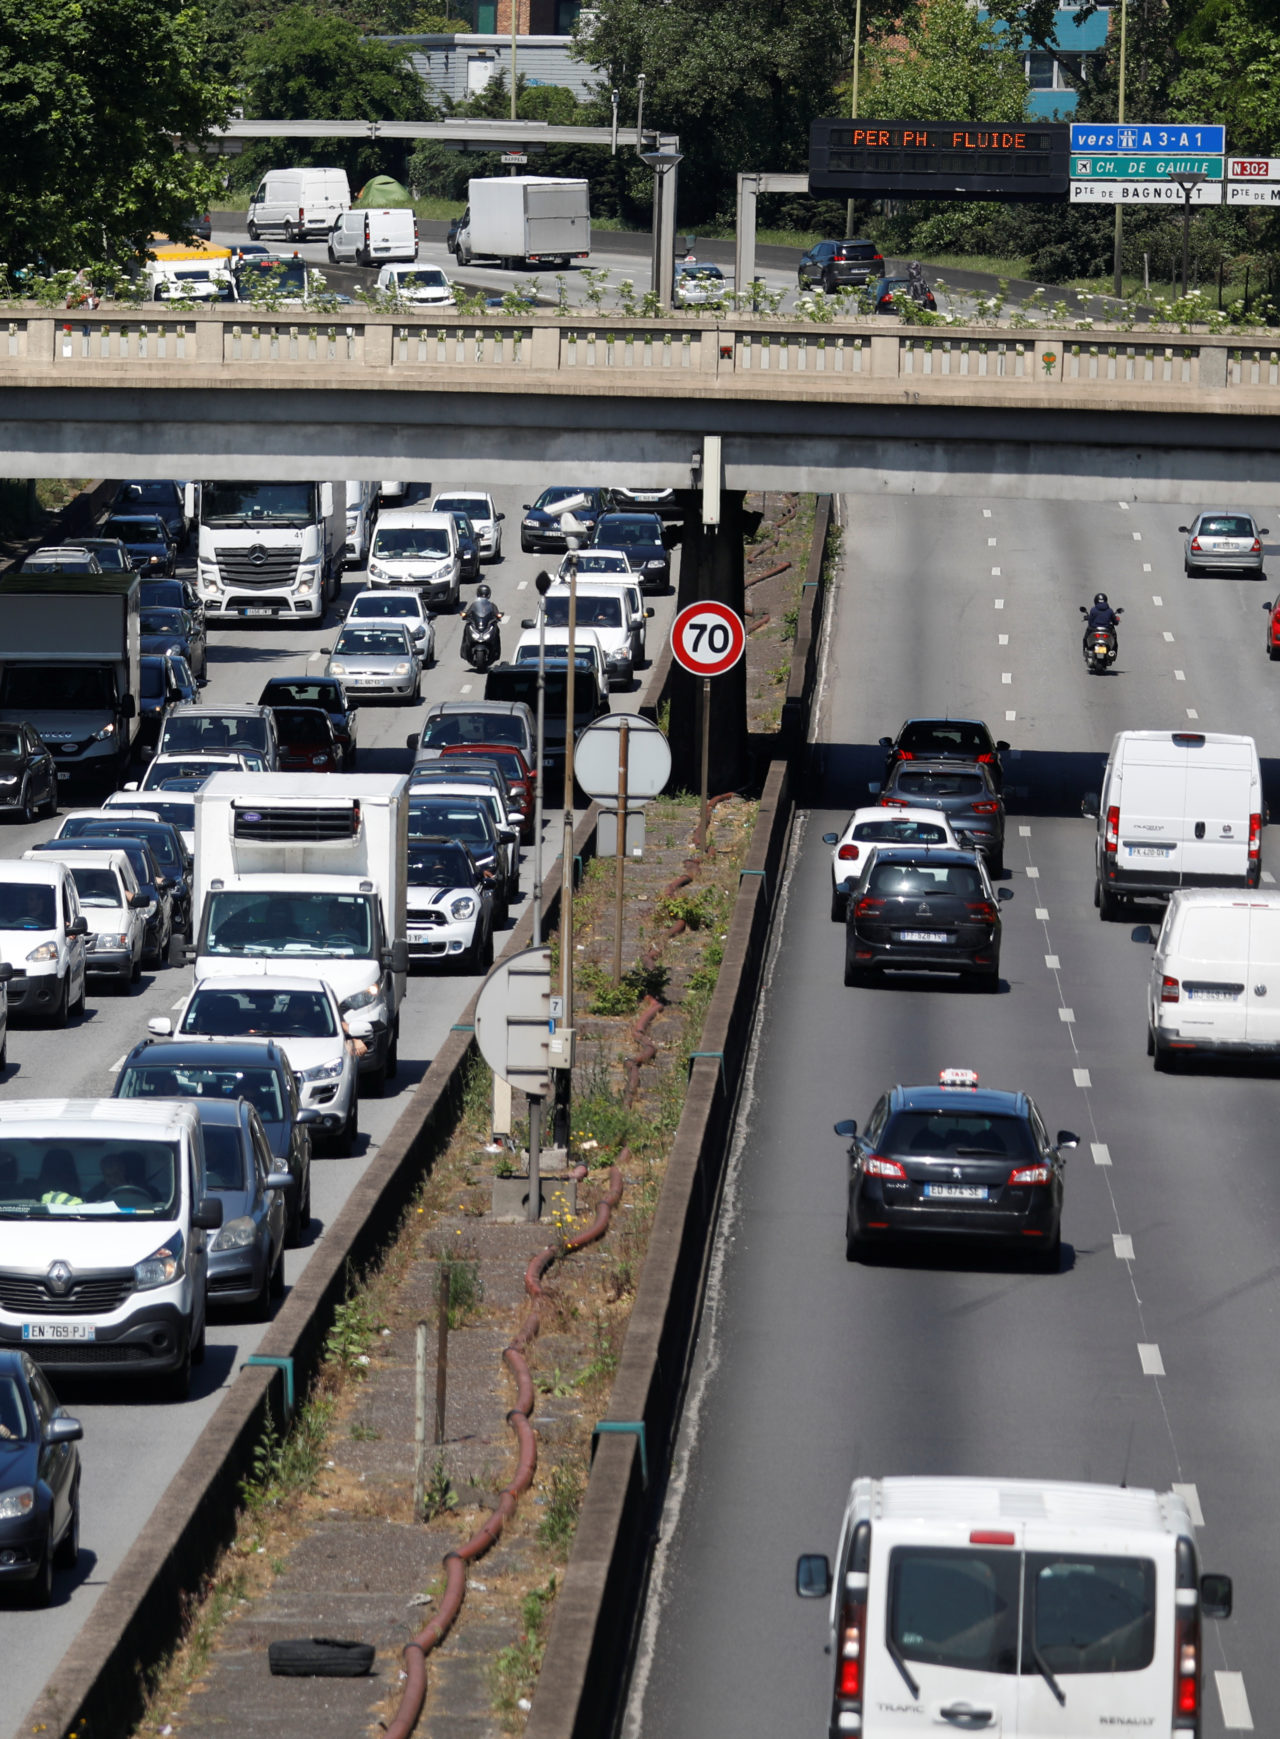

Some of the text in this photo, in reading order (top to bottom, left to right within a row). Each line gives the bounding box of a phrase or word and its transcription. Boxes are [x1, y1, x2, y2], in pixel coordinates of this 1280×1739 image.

[952, 132, 1026, 149] FLUIDE
[1078, 135, 1114, 145] vers
[1096, 162, 1118, 173] CH.
[1128, 162, 1146, 173] DE
[1122, 188, 1202, 199] BAGNOLT
[689, 623, 729, 653] 70
[951, 1071, 968, 1079] TAXI
[878, 1703, 925, 1714] TRAFIC
[1099, 1716, 1155, 1726] RENAULT
